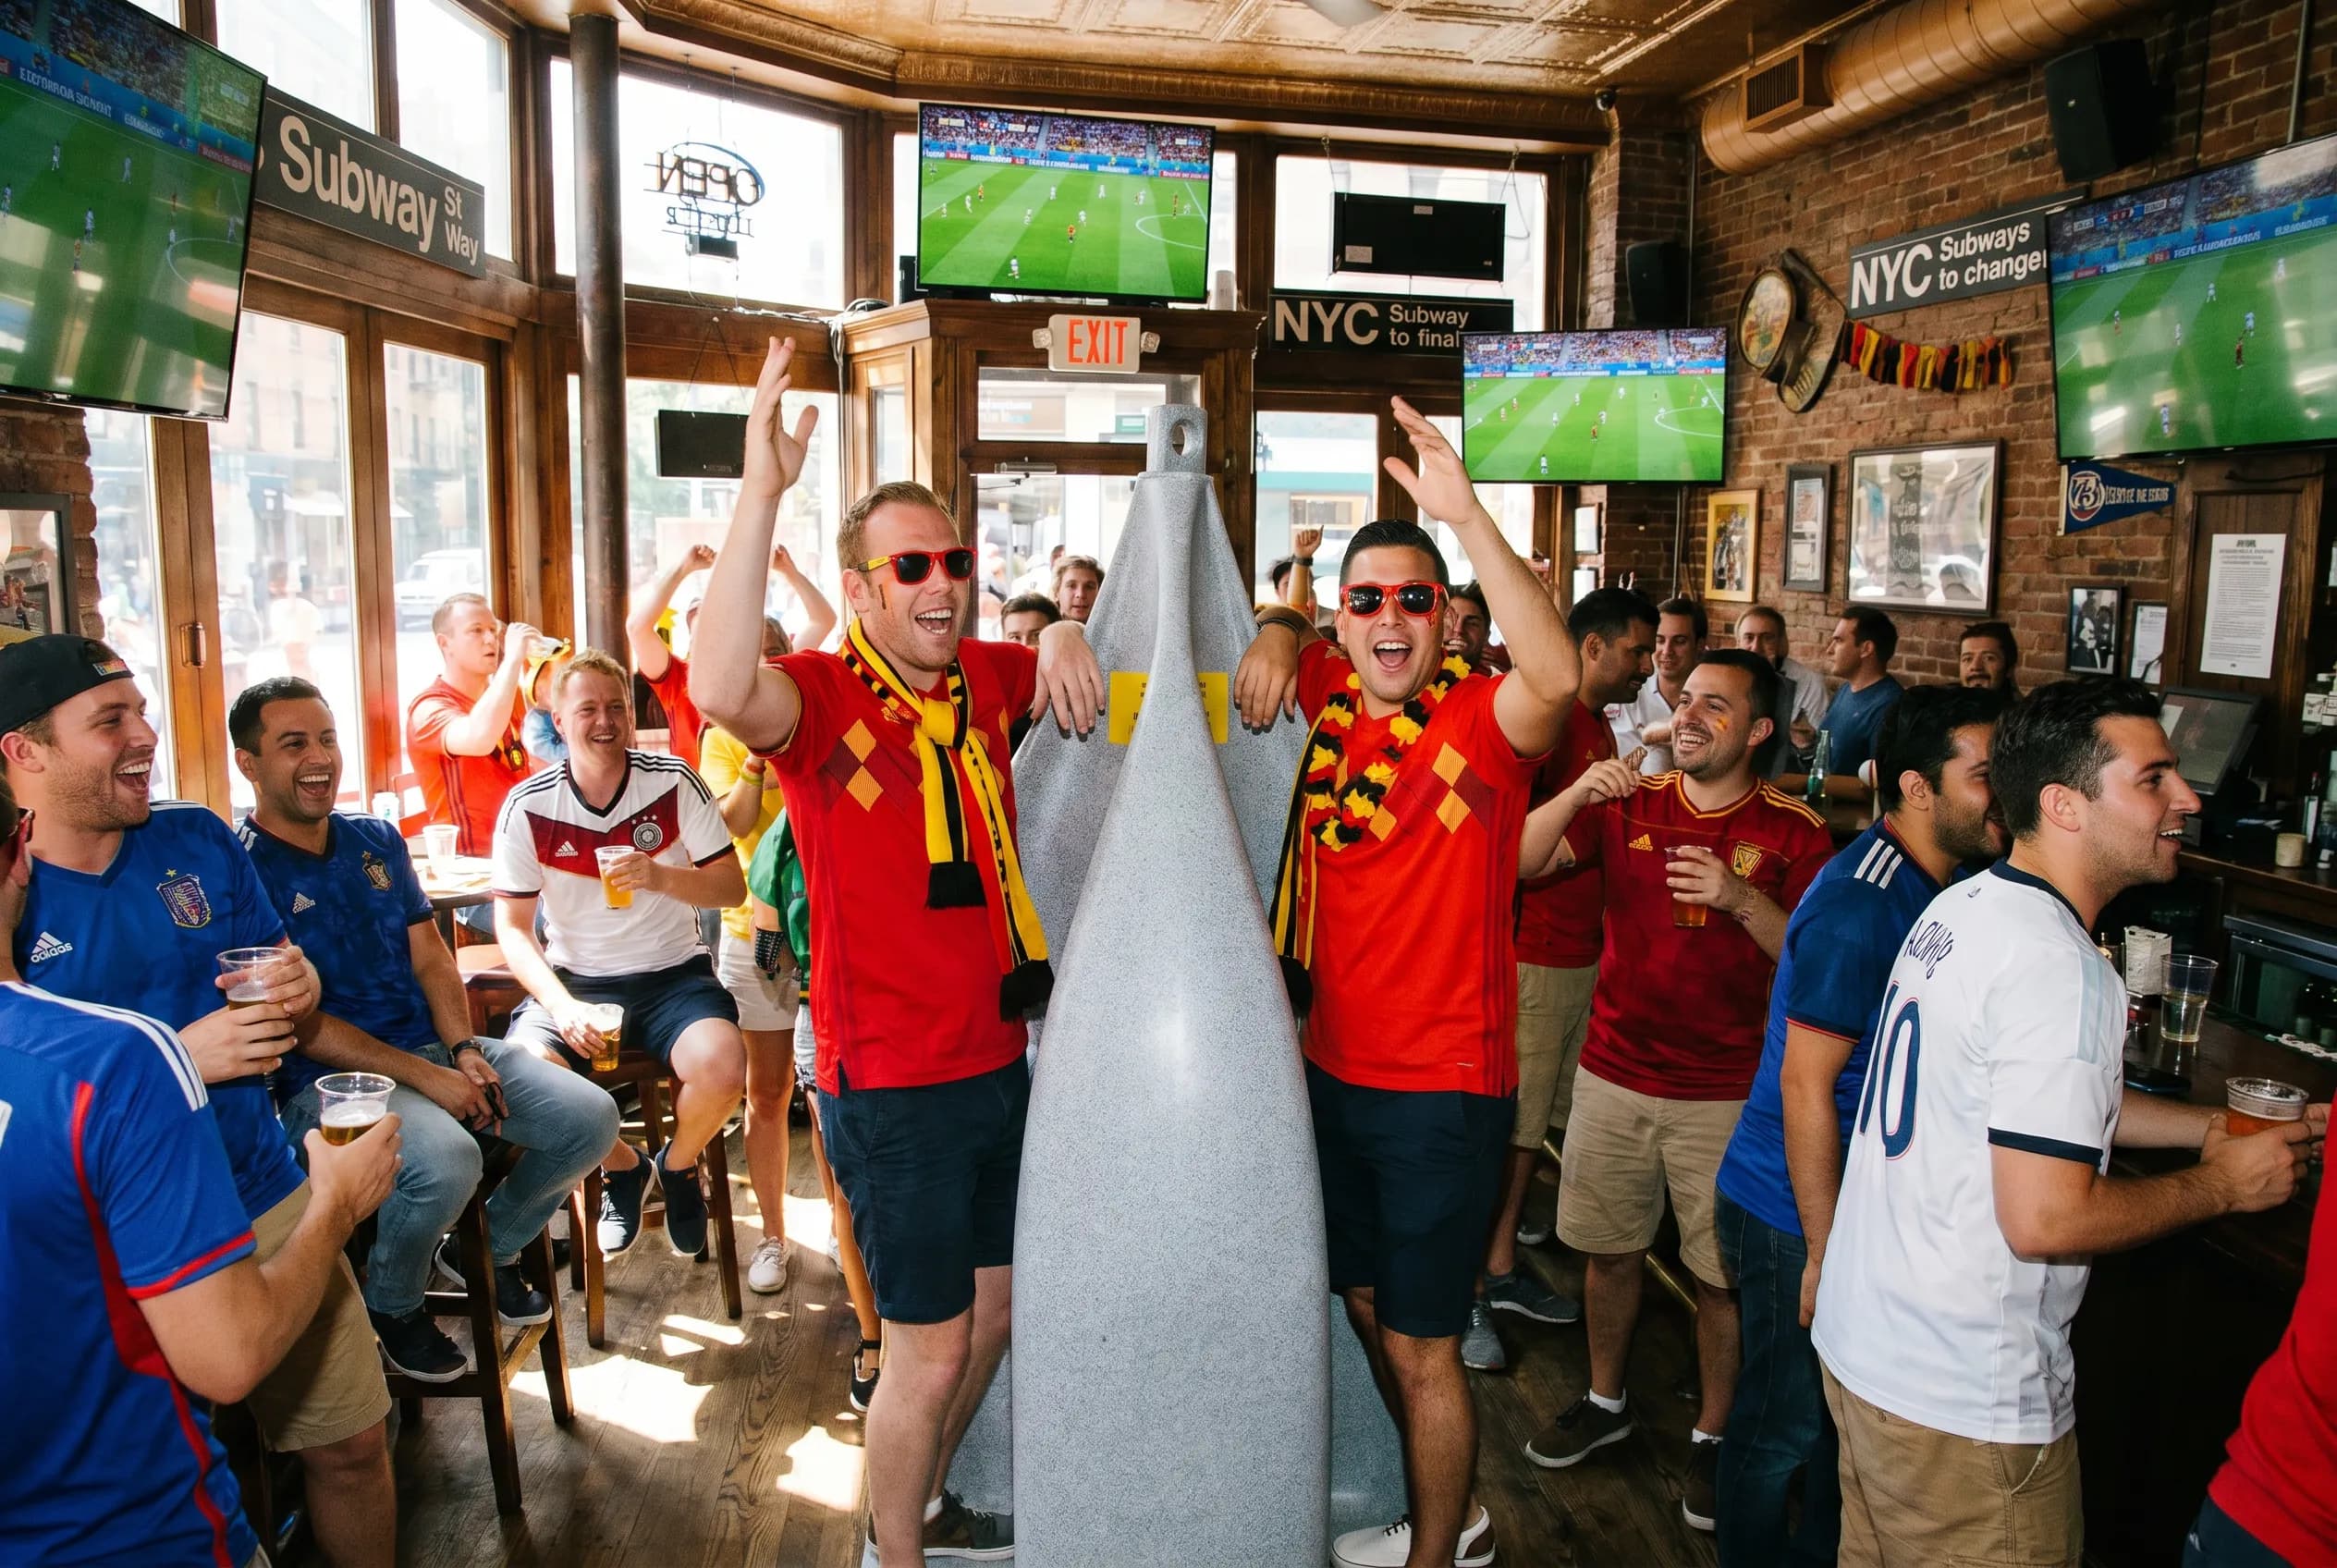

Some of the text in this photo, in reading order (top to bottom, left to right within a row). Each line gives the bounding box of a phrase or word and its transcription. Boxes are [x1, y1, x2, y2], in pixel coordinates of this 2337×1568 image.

[279, 115, 437, 253] Subway
[444, 186, 463, 220] St
[444, 221, 480, 266] Way
[1939, 222, 2031, 262] Subways
[1851, 243, 1933, 309] NYC
[1939, 267, 1959, 290] to
[1275, 300, 1378, 345] NYC
[1389, 303, 1469, 328] Subway
[1389, 327, 1460, 348] to final
[1068, 319, 1128, 364] EXIT
[1859, 980, 1921, 1161] 10
